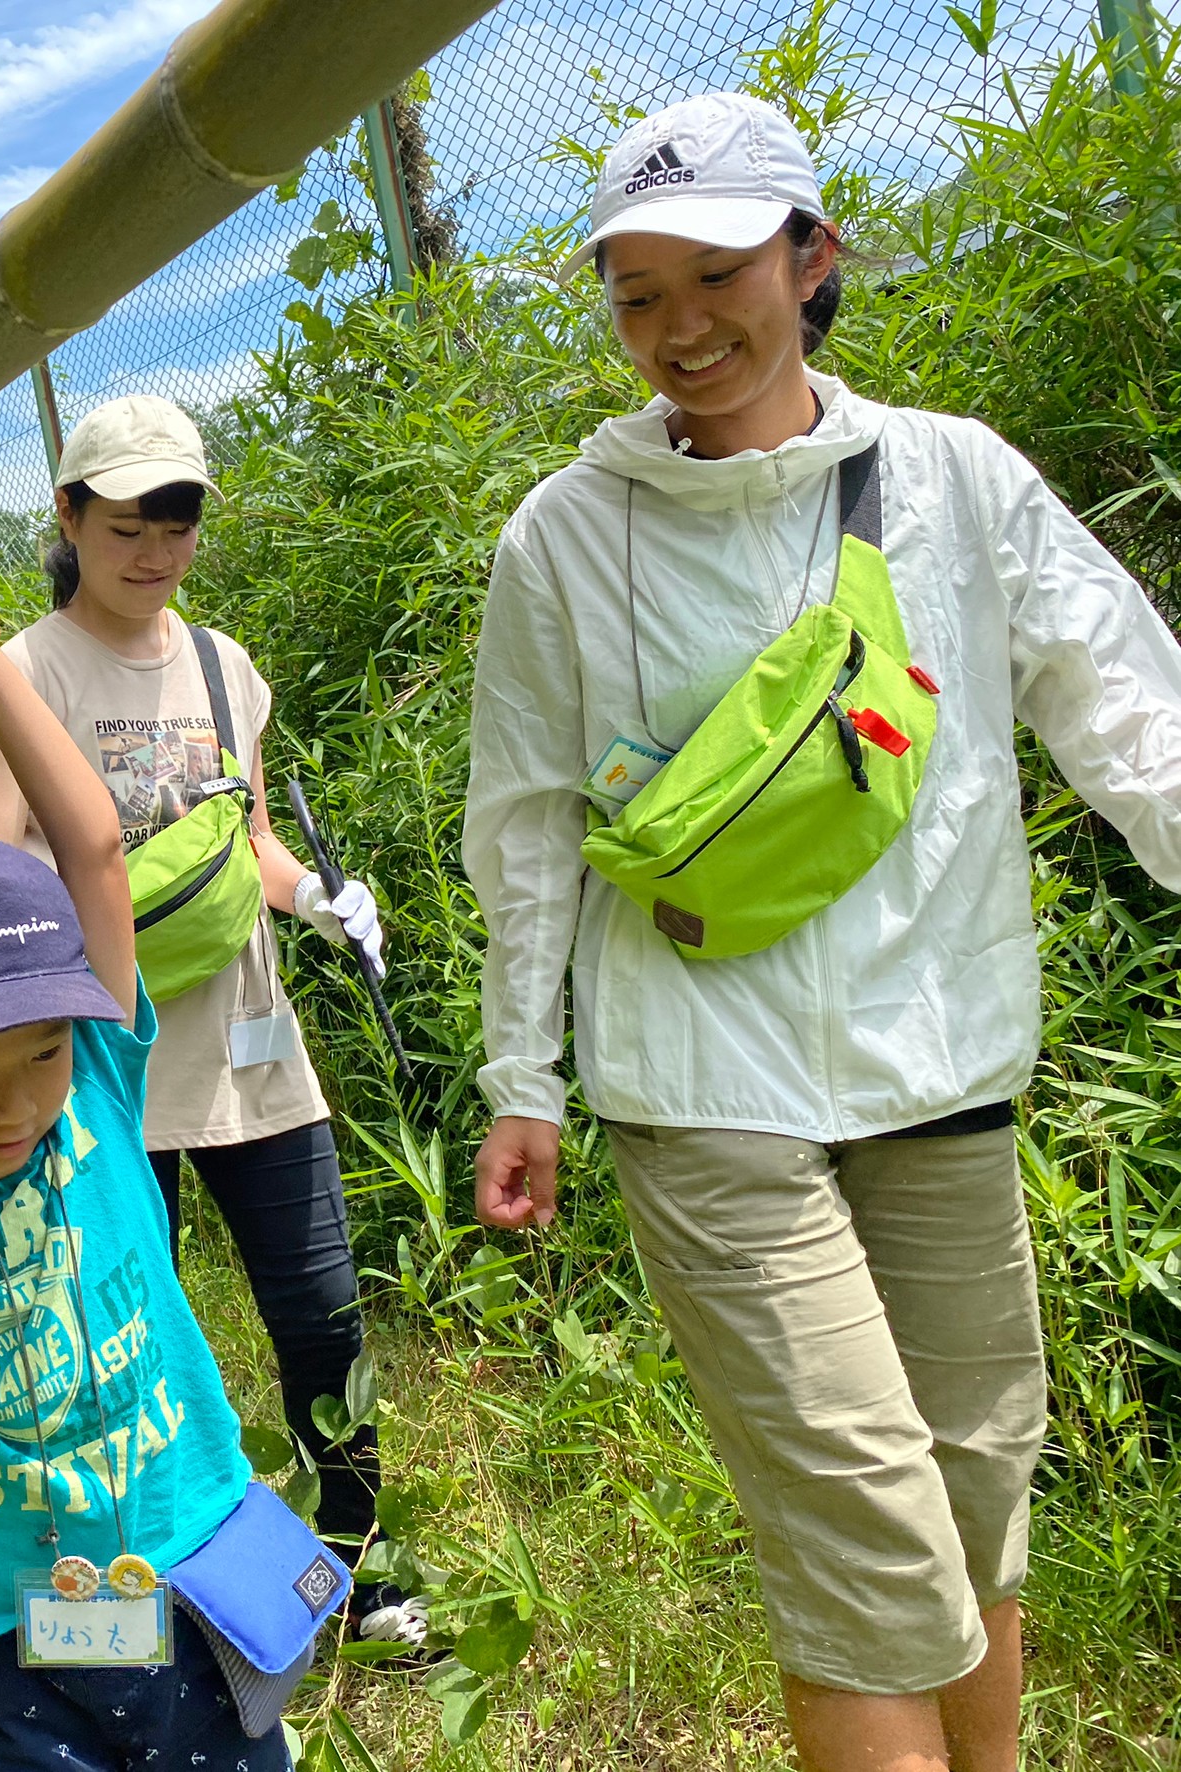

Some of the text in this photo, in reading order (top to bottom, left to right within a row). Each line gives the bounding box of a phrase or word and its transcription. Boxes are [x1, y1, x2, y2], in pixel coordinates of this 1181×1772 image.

[625, 169, 695, 195] adidas
[95, 720, 127, 733] FIND
[128, 719, 161, 732] YOUR
[162, 717, 195, 731] TRUE
[120, 828, 148, 844] OAR
